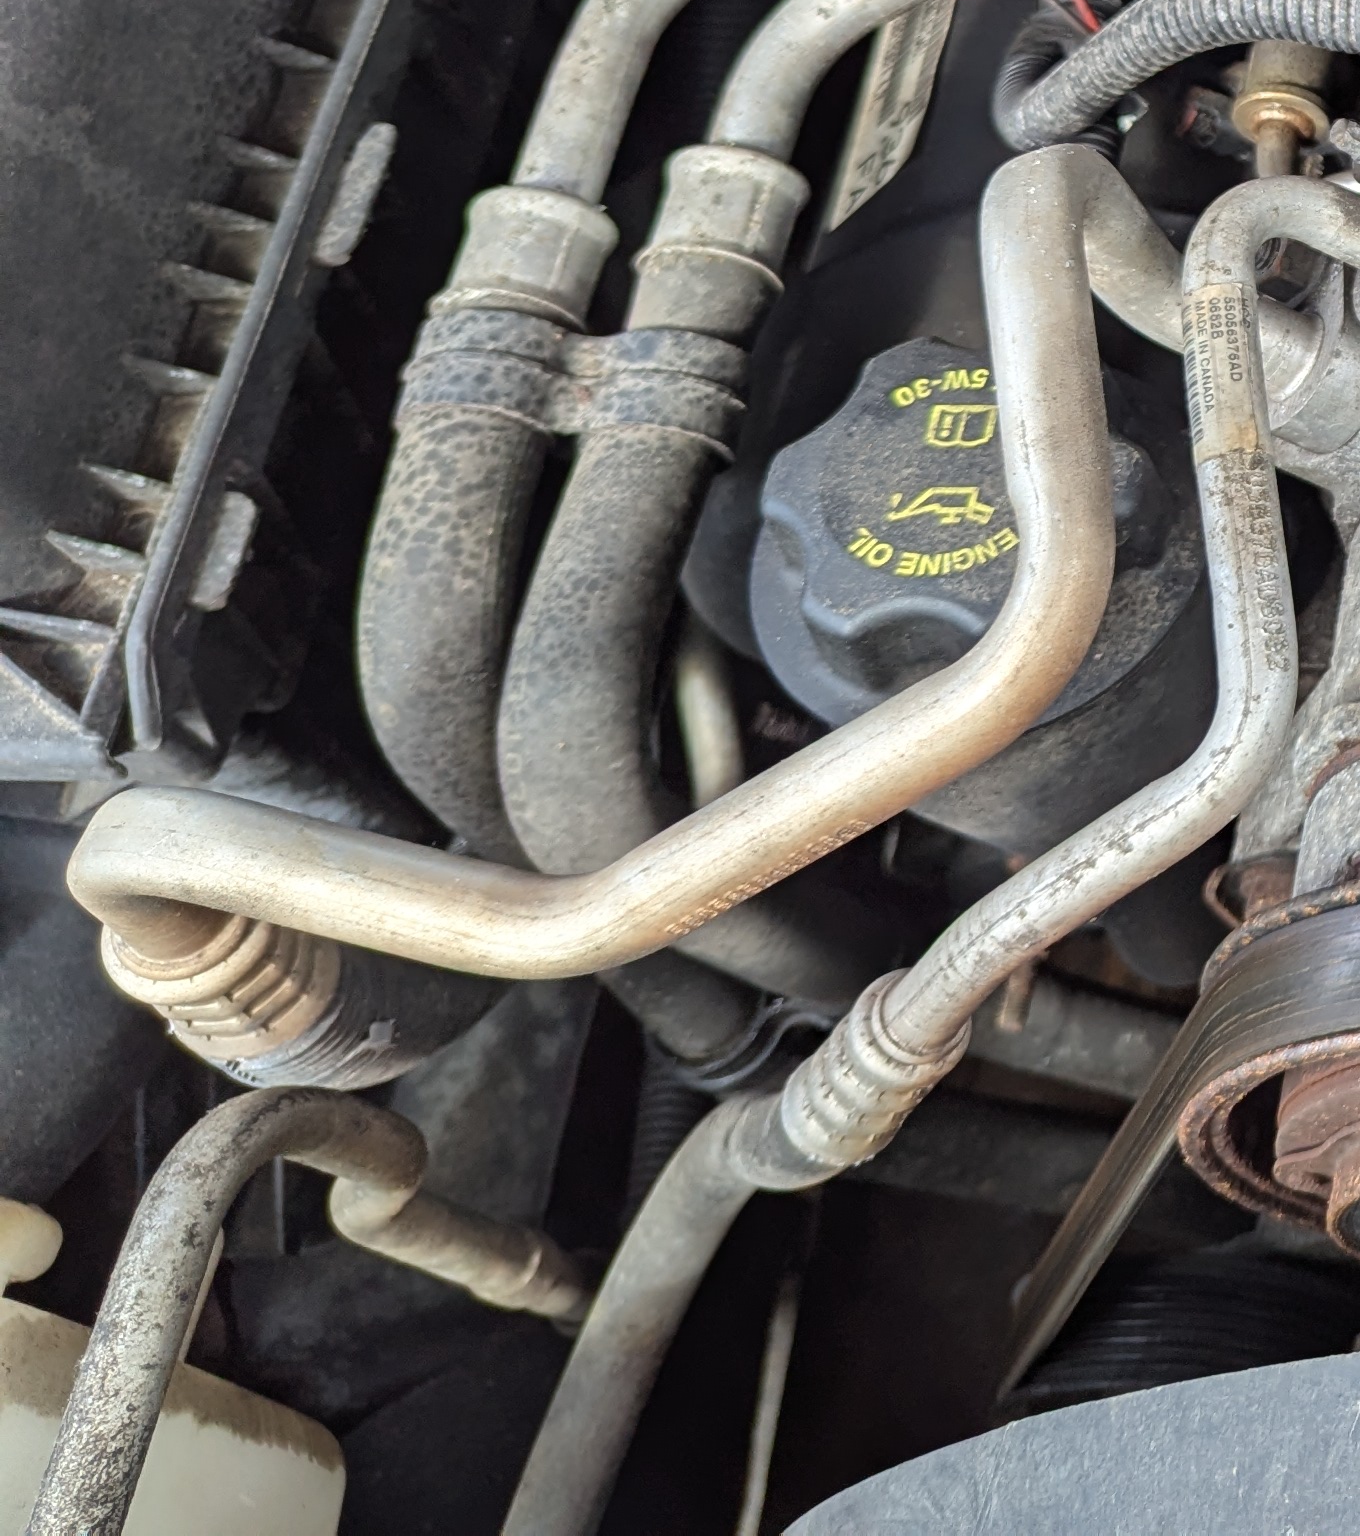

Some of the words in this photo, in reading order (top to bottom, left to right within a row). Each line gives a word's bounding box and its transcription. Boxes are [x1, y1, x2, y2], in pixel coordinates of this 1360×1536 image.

[1195, 300, 1208, 337] MADE
[1199, 340, 1209, 355] IN
[890, 368, 990, 407] 5W-30
[1200, 358, 1215, 413] CANADA
[848, 527, 894, 567] OIL
[896, 526, 1020, 576] ENGINE
